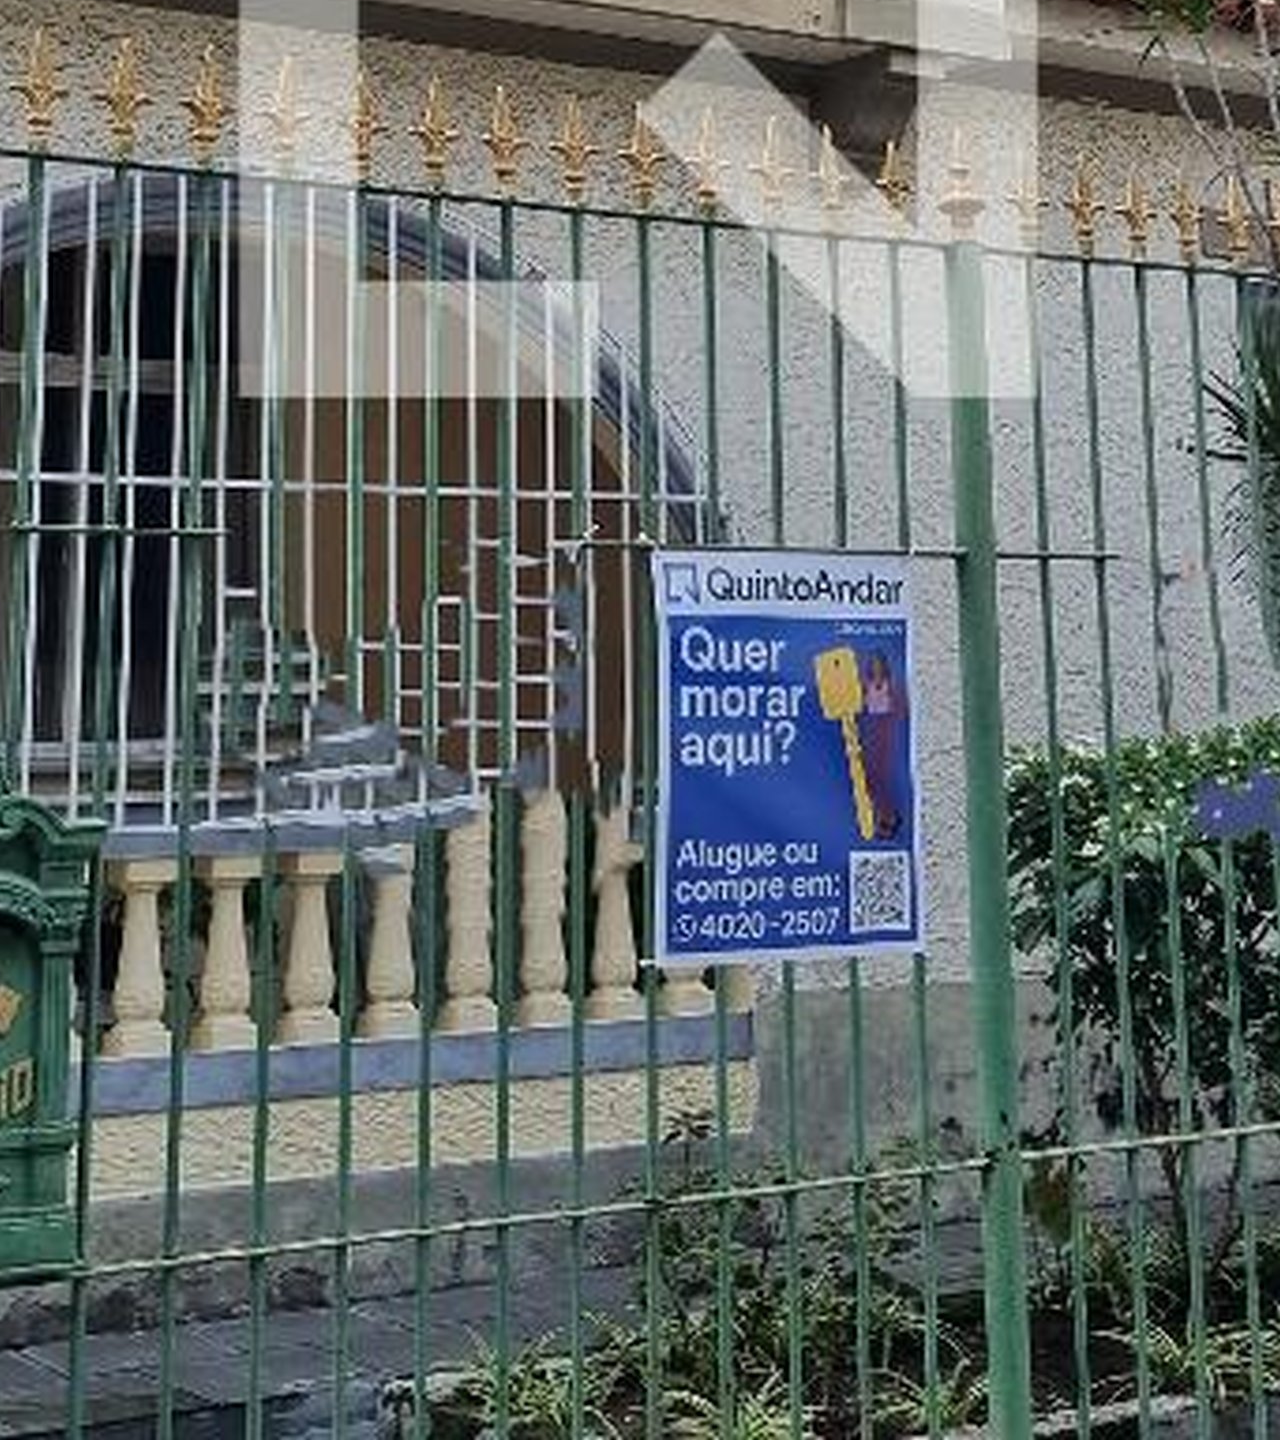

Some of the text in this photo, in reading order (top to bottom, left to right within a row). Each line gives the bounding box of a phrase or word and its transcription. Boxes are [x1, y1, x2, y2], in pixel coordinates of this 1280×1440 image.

[706, 567, 905, 606] QuintoAndar
[679, 625, 786, 674] Quer
[679, 682, 806, 719] morar
[679, 722, 797, 777] aqui?
[676, 838, 819, 875] Alugue ou
[674, 873, 842, 907] compre em:
[698, 906, 841, 941] 4020-2507
